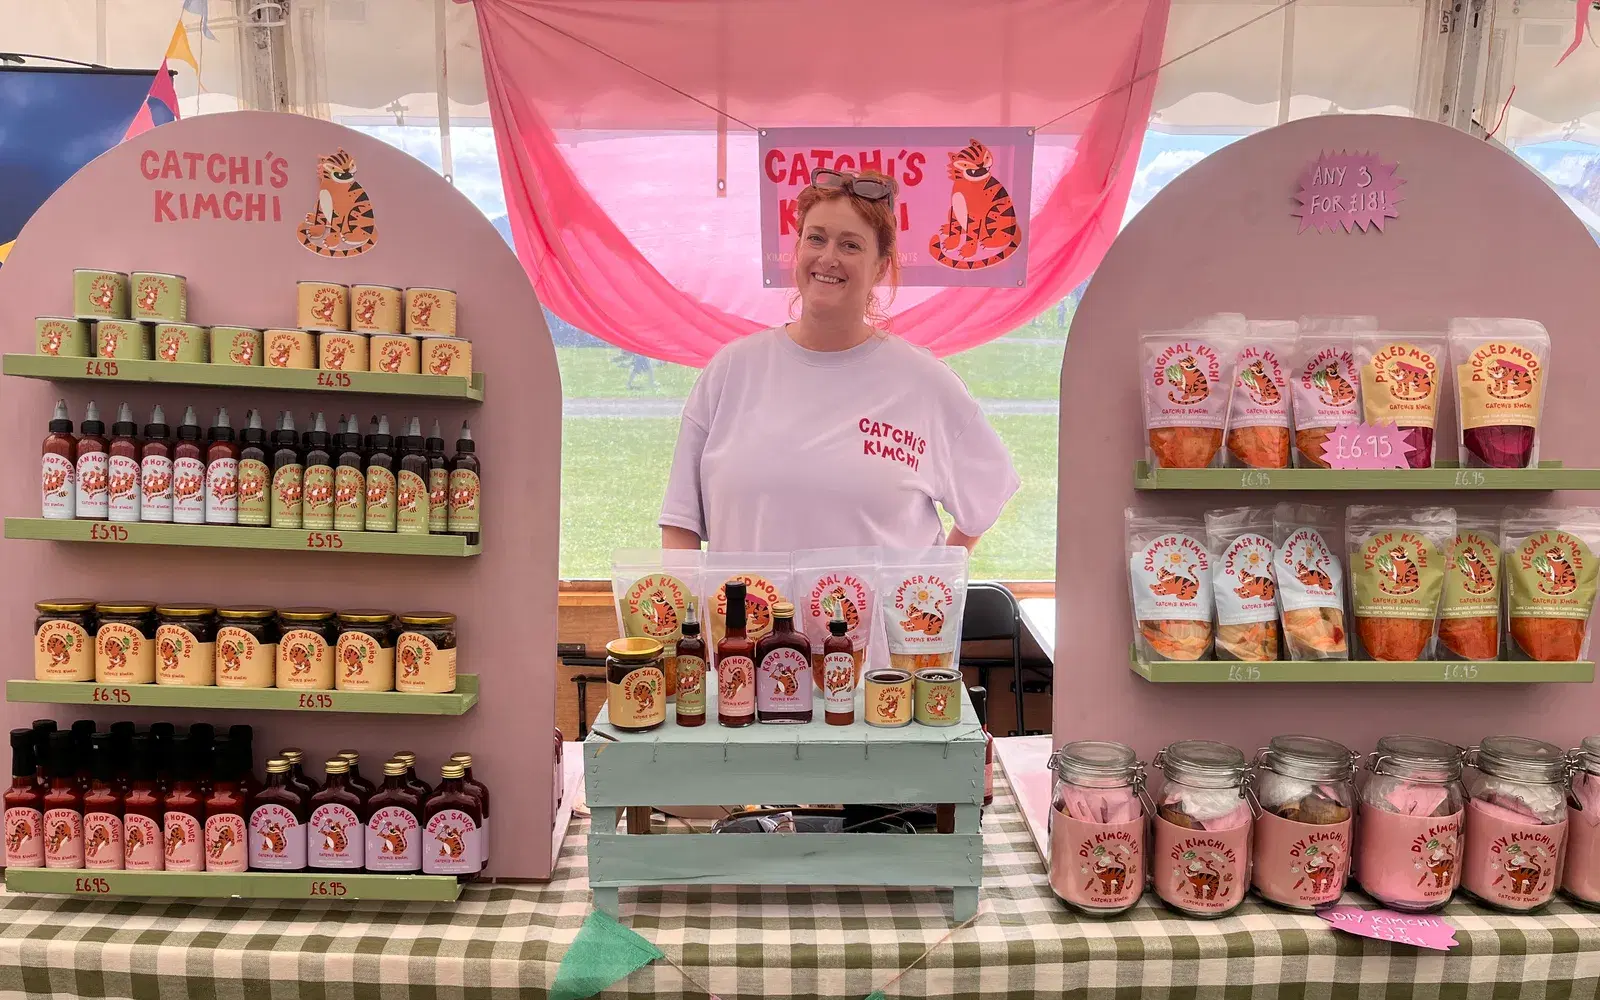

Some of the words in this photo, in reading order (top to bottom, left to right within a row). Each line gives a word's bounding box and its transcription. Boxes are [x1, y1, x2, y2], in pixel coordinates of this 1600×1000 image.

[140, 150, 288, 189] CATCHI'S
[765, 149, 926, 186] CATCHI'S
[1313, 166, 1347, 187] ANY
[1357, 166, 1372, 188] 3
[154, 190, 281, 222] KIMCHI
[1310, 194, 1345, 214] FOR
[1348, 190, 1386, 214] £18!
[92, 275, 112, 290] SEAWEED
[114, 279, 123, 292] SALT
[138, 277, 156, 292] SEAWEED
[159, 279, 168, 294] SALT
[314, 288, 343, 304] GOCHUGARU
[357, 290, 385, 306] GOCHUGARU
[412, 293, 441, 308] GOCHUGARU
[41, 322, 60, 337] SEAWEED
[62, 324, 72, 338] SALT
[160, 328, 177, 343] SEAWEED
[179, 330, 190, 344] SALT
[271, 334, 301, 350] GOCHUGARU
[326, 337, 355, 353] GOCHUGARU
[381, 340, 411, 356] GOCHUGARU
[431, 343, 460, 359] GOCHUGARU
[86, 360, 118, 376] £4.95
[1155, 343, 1191, 386] ORIGINAL
[1196, 345, 1220, 383] KIMCHI
[1263, 350, 1285, 387] KIMCHI
[1304, 347, 1338, 389] ORIGINAL
[1375, 346, 1405, 383] PICKLED
[1472, 344, 1505, 382] PICKLED
[1510, 346, 1540, 384] MOOLI
[317, 372, 351, 387] £4.95
[859, 418, 926, 454] CATCHI'S
[1336, 435, 1392, 460] £6.95
[864, 440, 919, 472] KIMCHI
[412, 477, 424, 500] HONEY
[1241, 473, 1270, 487] £6.95
[1455, 471, 1485, 486] £6.95
[91, 524, 128, 541] £5.95
[307, 532, 343, 548] £5.95
[1144, 538, 1177, 572] SUMMER
[1182, 538, 1209, 571] KIMCHI
[1226, 538, 1253, 576] SUMMER
[1256, 537, 1272, 552] KIM
[1285, 531, 1308, 565] SUMMER
[1310, 533, 1330, 565] KIMCHI
[1364, 534, 1393, 570] VEGAN
[1401, 533, 1427, 568] KIMCHI
[1467, 534, 1497, 567] KIMCHI
[1520, 534, 1549, 571] VEGAN
[1556, 534, 1583, 571] KIMCHI
[630, 579, 653, 614] VEGAN
[659, 577, 685, 609] KIMCHI
[717, 576, 751, 616] PICD
[755, 580, 779, 607] MOOL
[810, 574, 840, 618] ORIGINAL
[844, 575, 866, 611] KIMCHI
[895, 575, 924, 610] SUMMER
[927, 575, 952, 606] KIMCHI
[40, 624, 53, 653] CANDIED
[56, 622, 84, 653] JALAPEÑOS
[113, 625, 141, 656] JALAPEÑOS
[167, 627, 193, 659] JALAPEÑOS
[228, 630, 255, 661] JALAPEÑOS
[282, 633, 296, 662] CANDIED
[299, 632, 325, 663] JALAPEÑOS
[338, 634, 350, 663] CANDIED
[351, 633, 376, 665] JALAPEÑOS
[408, 634, 433, 666] JALAPEÑOS
[763, 652, 780, 672] KBBQ
[784, 651, 806, 671] SAUCE
[1228, 666, 1261, 681] £6.95
[1444, 665, 1478, 680] £6.95
[93, 688, 131, 703] £6.95
[625, 673, 639, 700] CANDIED
[879, 687, 906, 701] GOCHUGARU
[299, 694, 333, 709] £6.95
[31, 813, 41, 837] SAUCE
[71, 815, 80, 838] SAUCE
[252, 808, 268, 828] KBBQ
[273, 808, 296, 828] SAUCE
[312, 808, 329, 828] KBBQ
[333, 807, 357, 828] SAUCE
[370, 810, 390, 831] KBBQ
[394, 810, 416, 830] SAUCE
[428, 813, 447, 834] KBBQ
[451, 812, 473, 833] SAUCE
[109, 818, 119, 842] SAUCE
[144, 821, 153, 845] SAUCE
[186, 819, 195, 842] SAUCE
[1411, 834, 1427, 853] DIY
[1429, 823, 1456, 837] KIMC
[1079, 841, 1093, 858] DIY
[1095, 831, 1130, 843] KIMCHI
[1130, 839, 1139, 855] KIT
[1171, 845, 1184, 861] DIY
[1185, 837, 1225, 850] KIMCHI
[1224, 848, 1236, 864] KIT
[1290, 840, 1306, 857] DIY
[1309, 831, 1343, 844] KIMCHI
[1491, 838, 1508, 853] DIY
[1511, 831, 1551, 845] KIMCHI
[1549, 844, 1557, 858] KIT
[76, 878, 110, 893] £6.95
[310, 881, 347, 897] £6.95
[1333, 912, 1364, 923] DIY
[1372, 915, 1439, 927] KIMCHI
